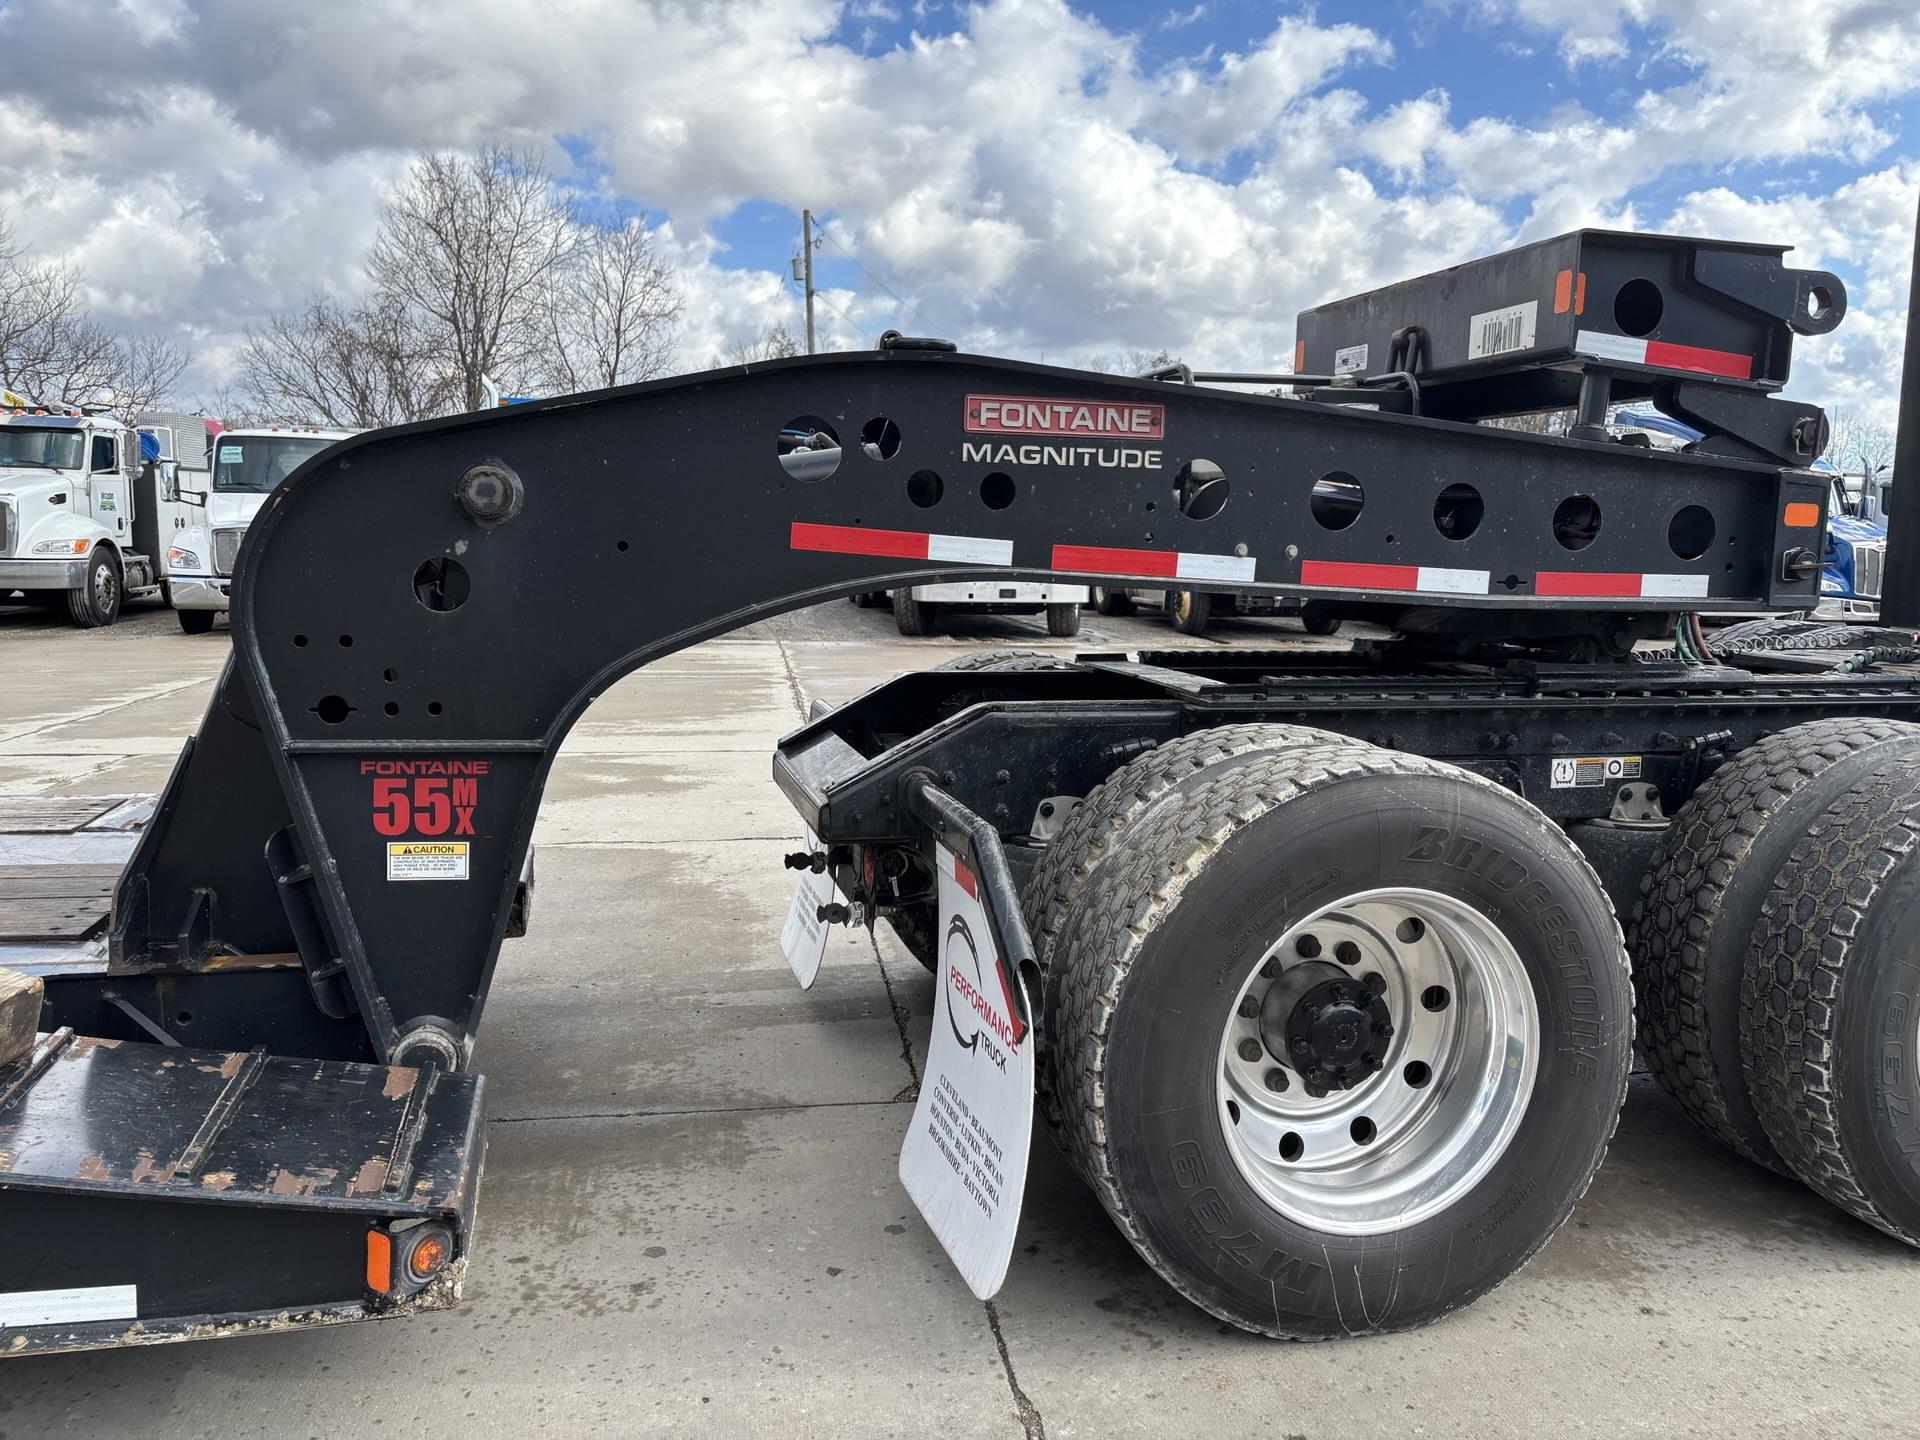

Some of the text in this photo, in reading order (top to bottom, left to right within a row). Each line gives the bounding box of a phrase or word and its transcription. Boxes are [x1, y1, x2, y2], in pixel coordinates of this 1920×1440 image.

[962, 442, 1163, 470] MAGNITUDE
[979, 401, 1151, 433] FONTAINE
[360, 760, 489, 775] FONTAINE
[413, 845, 455, 854] CAUTION
[1401, 825, 1601, 1083] BRIDGESTONE
[950, 965, 1019, 1056] PERFORMANCE
[980, 1030, 1007, 1075] TRUCK
[929, 1101, 1000, 1208] HOUSTON BUDA VICTORIA
[933, 1086, 1005, 1188] CONVERSE LUFKIN BRYAN
[939, 1073, 1004, 1163] CLEVELAND BEAUMONT
[927, 1122, 994, 1221] BROOKSHIRE BAYTOWN
